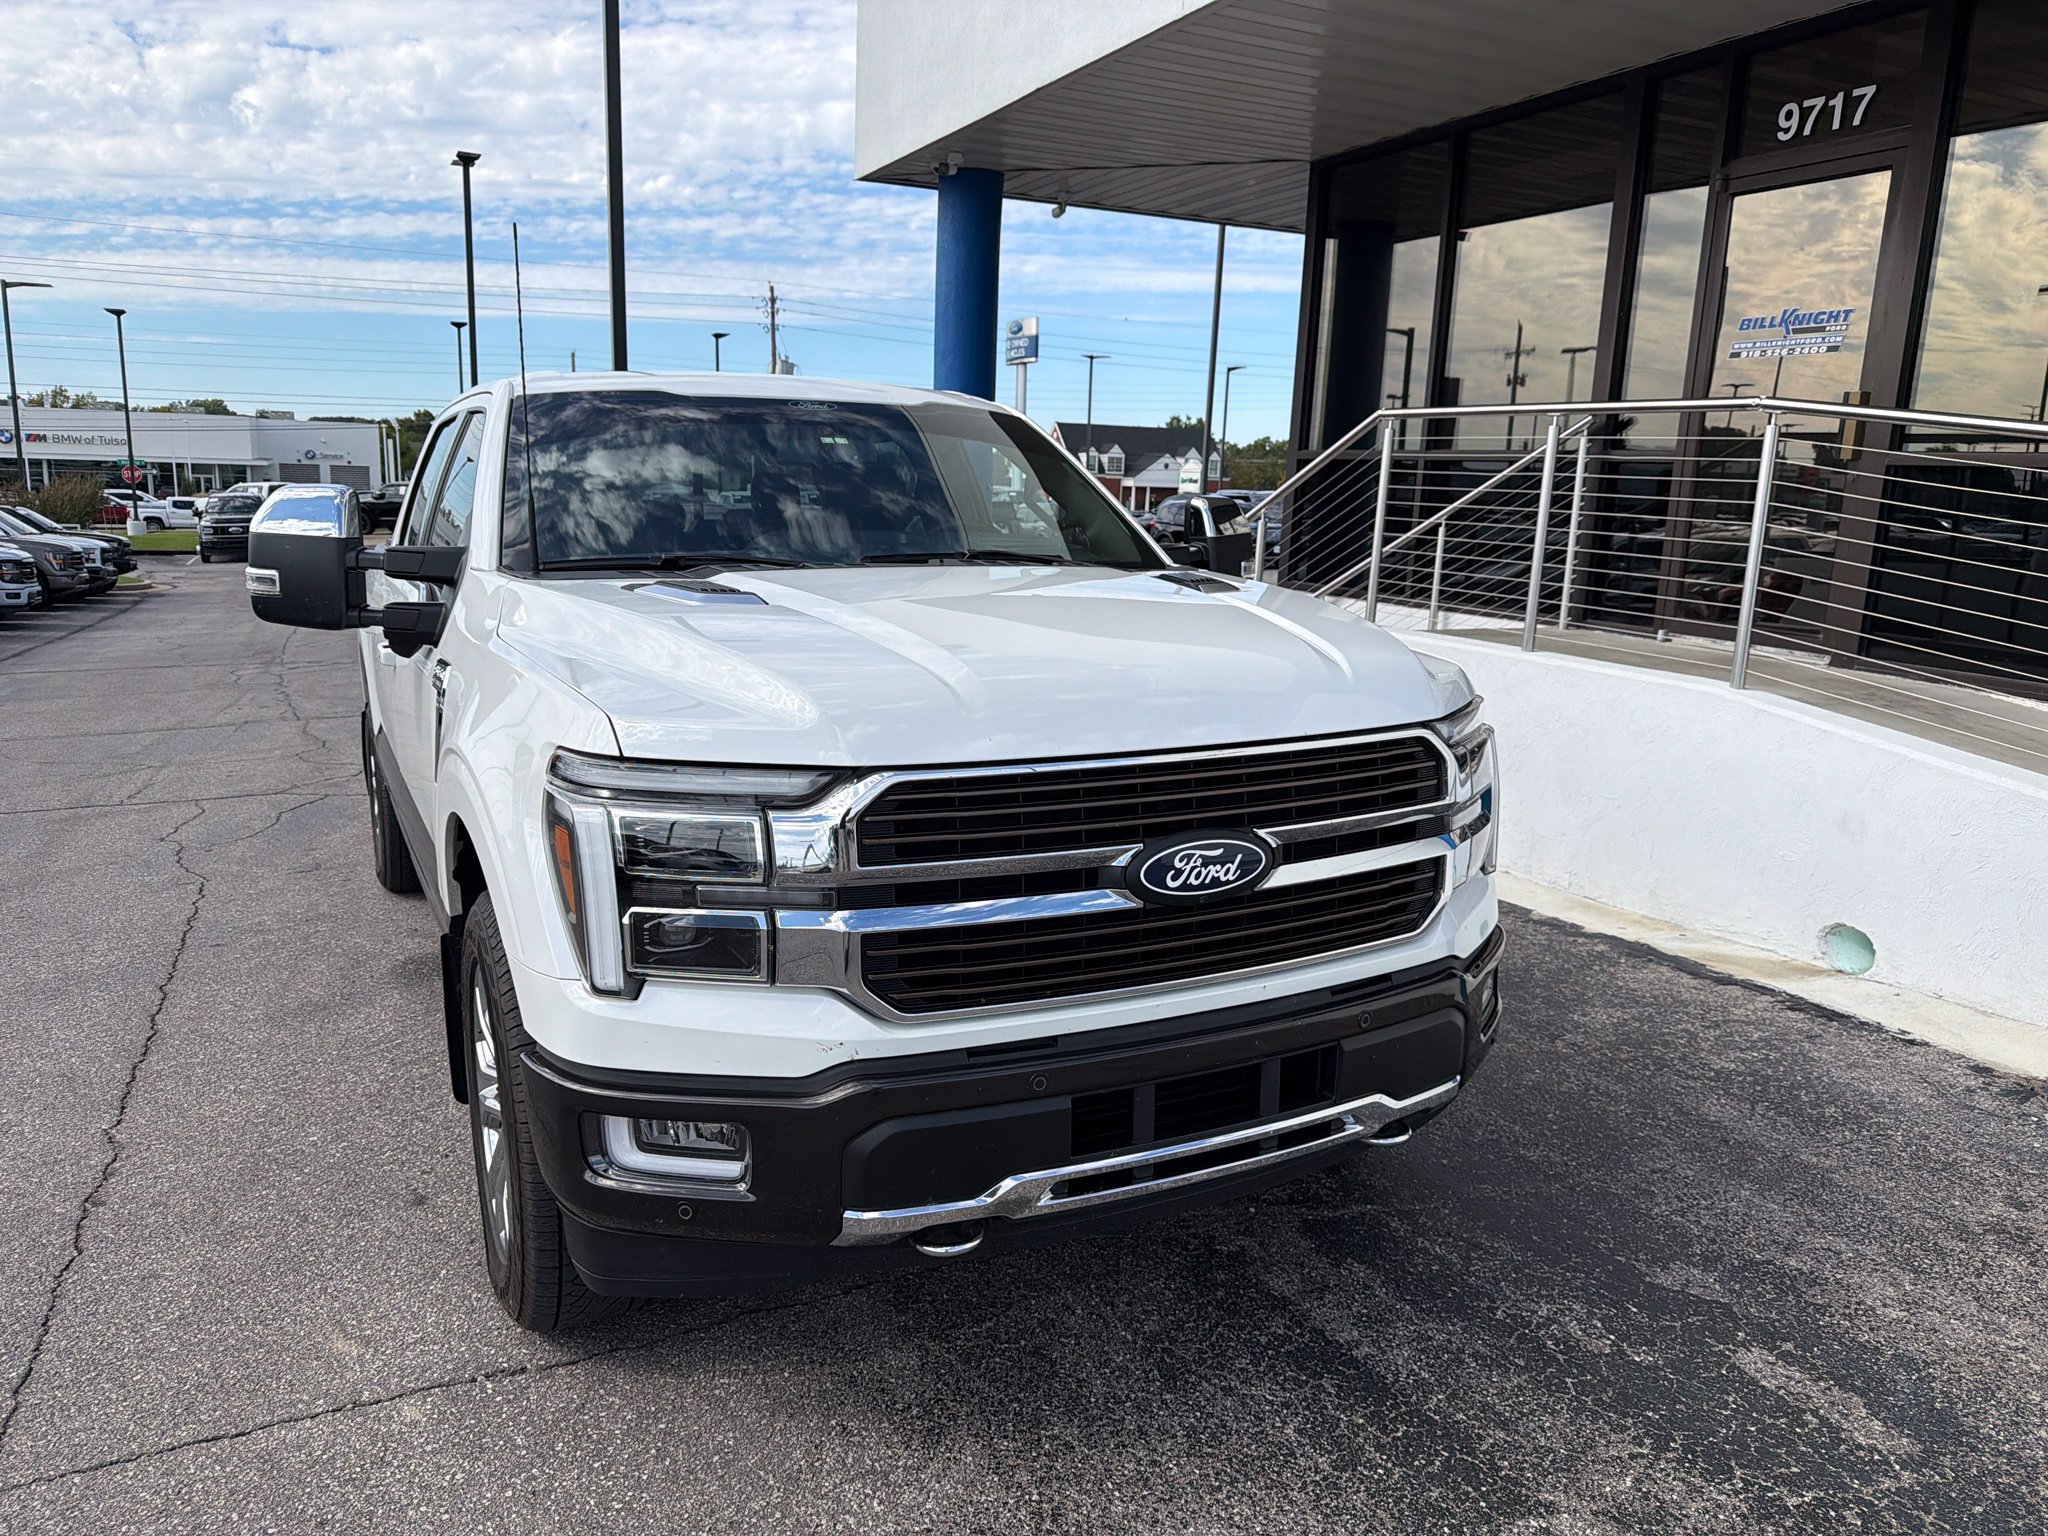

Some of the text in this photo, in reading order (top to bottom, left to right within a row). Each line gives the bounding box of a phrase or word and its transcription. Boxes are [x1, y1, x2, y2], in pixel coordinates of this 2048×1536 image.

[1776, 84, 1877, 141] 9717
[1740, 346, 1828, 358] 918-526-2400
[52, 433, 82, 444] BMW
[84, 434, 95, 444] of
[97, 435, 127, 445] Tulsa
[123, 470, 140, 478] STP
[1165, 848, 1243, 888] Ford
